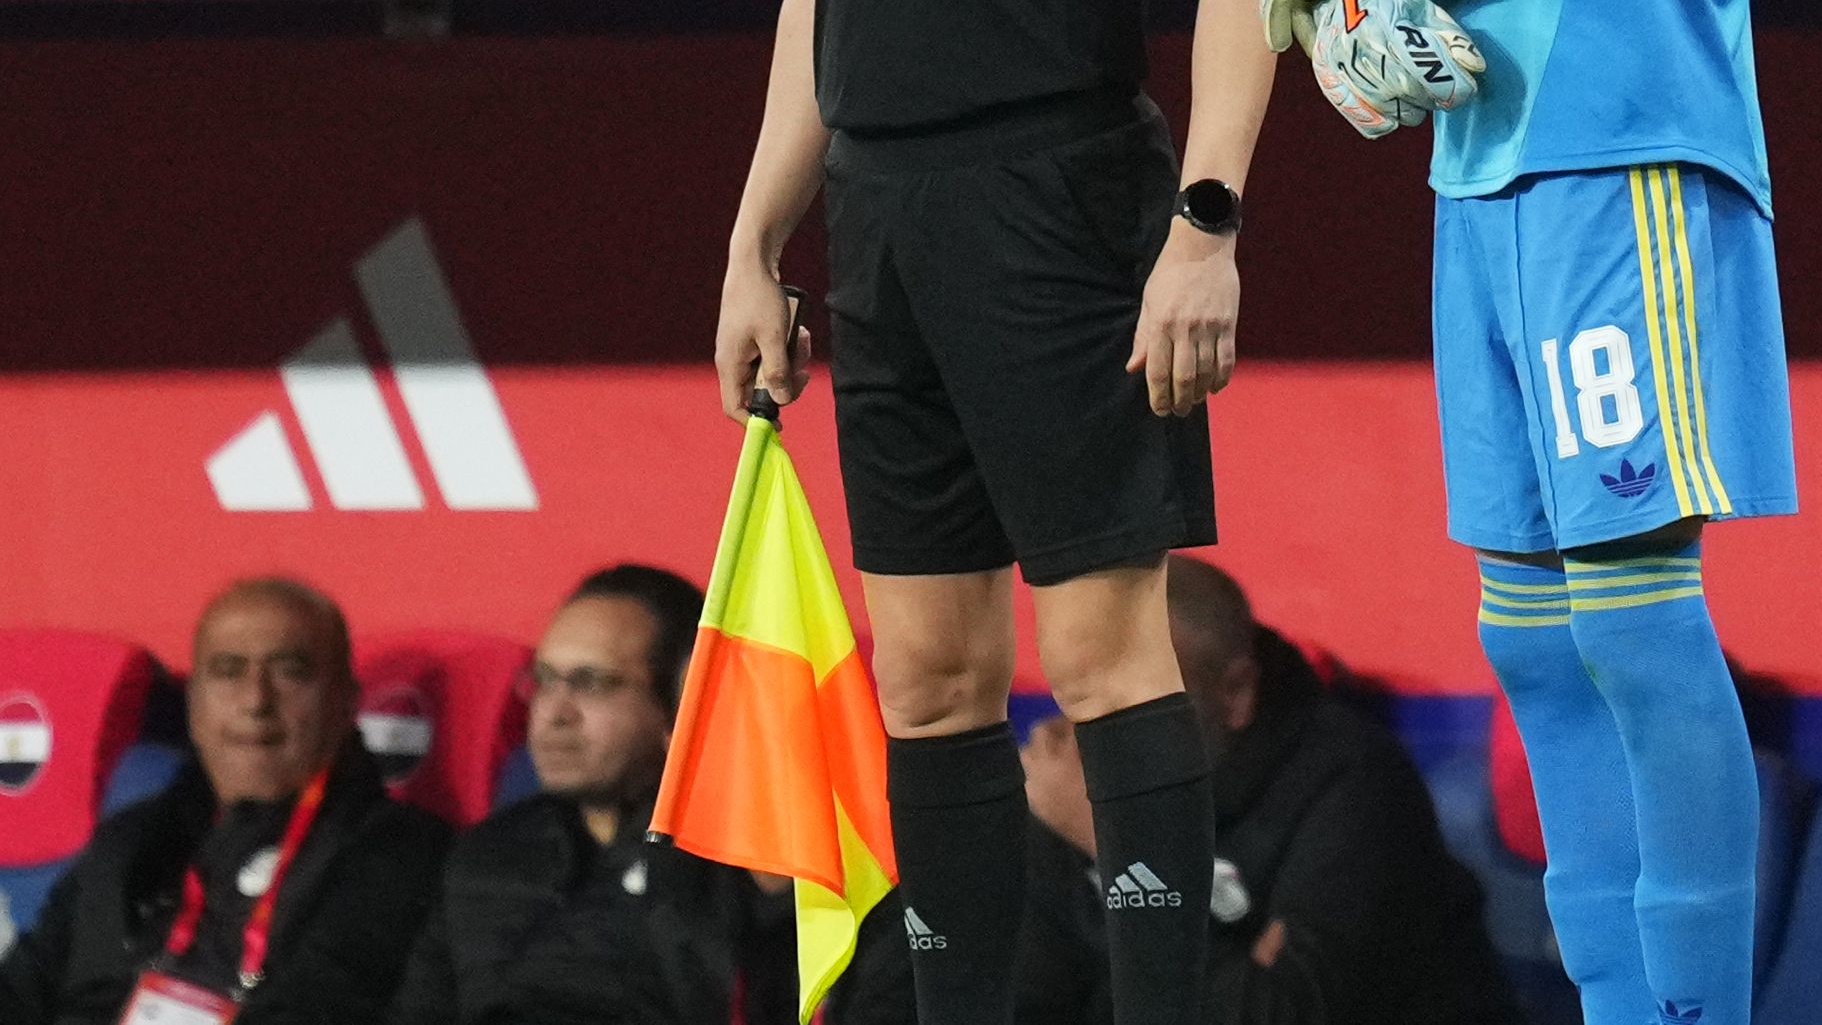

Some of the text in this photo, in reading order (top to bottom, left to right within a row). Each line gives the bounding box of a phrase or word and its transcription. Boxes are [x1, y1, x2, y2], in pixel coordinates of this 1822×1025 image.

[1541, 325, 1643, 459] 18
[1106, 889, 1182, 909] adidas
[908, 933, 948, 951] das
